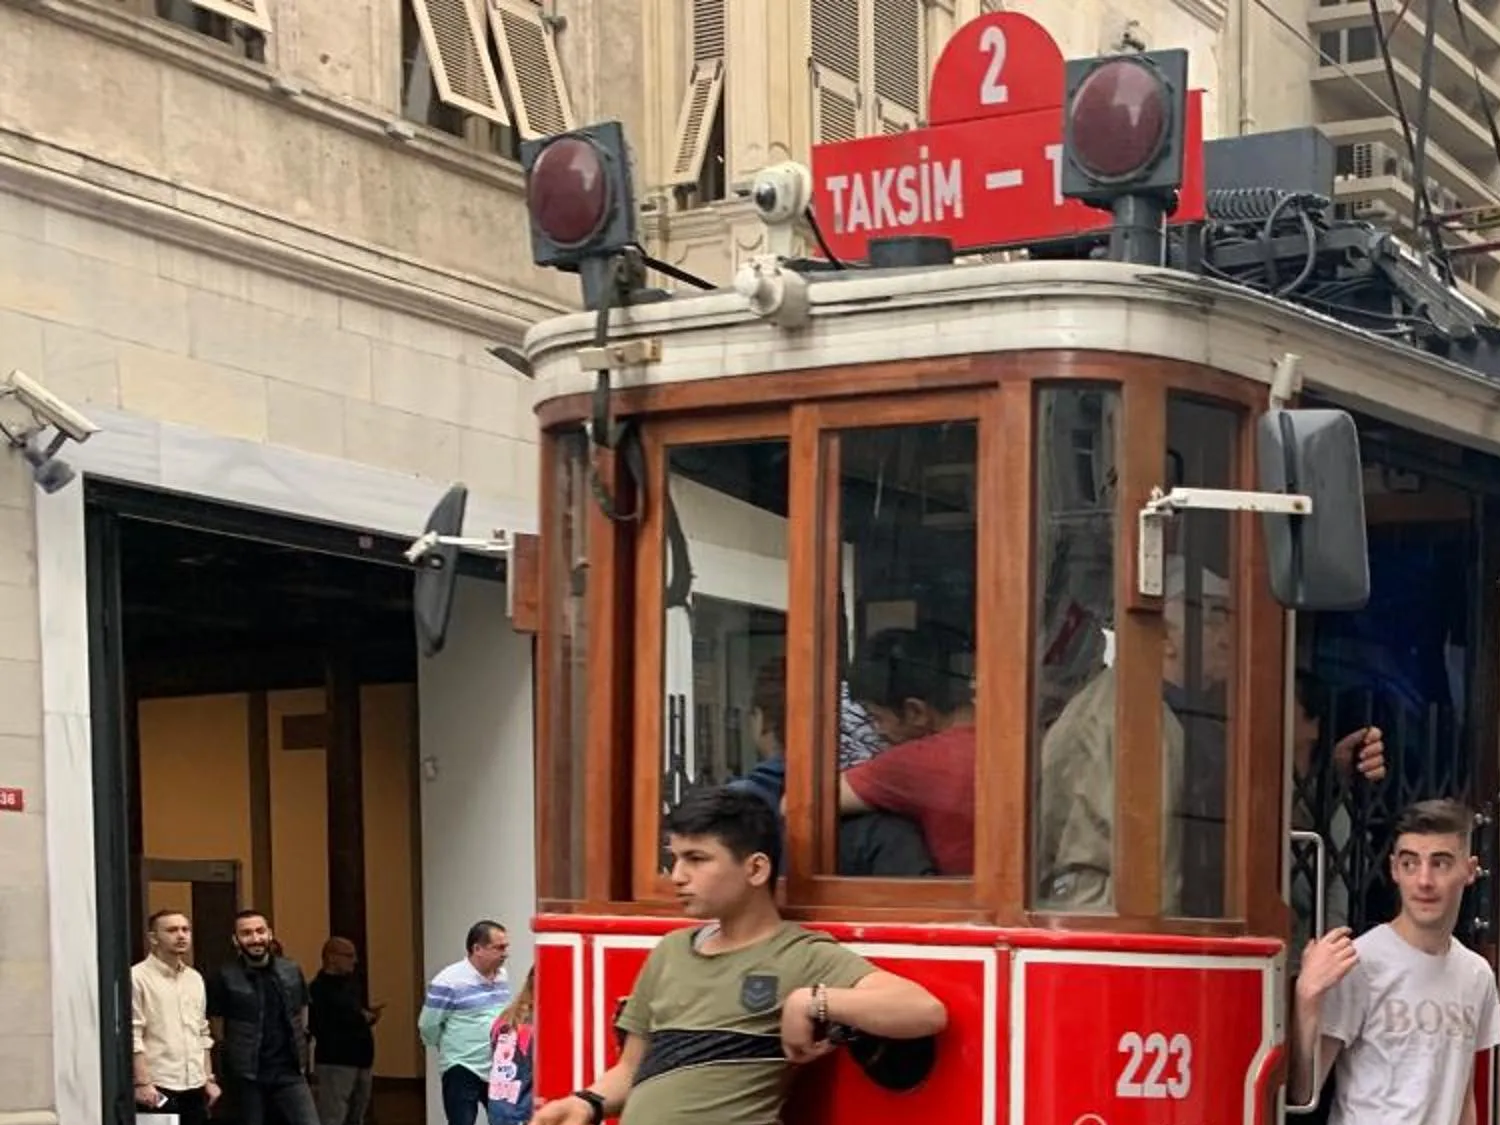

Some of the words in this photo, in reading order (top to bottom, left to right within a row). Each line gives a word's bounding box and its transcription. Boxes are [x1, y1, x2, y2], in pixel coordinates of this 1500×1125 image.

[979, 26, 1009, 105] 2
[826, 146, 964, 234] TAKSİM
[1384, 998, 1476, 1040] BOSS
[1116, 1031, 1192, 1099] 223
